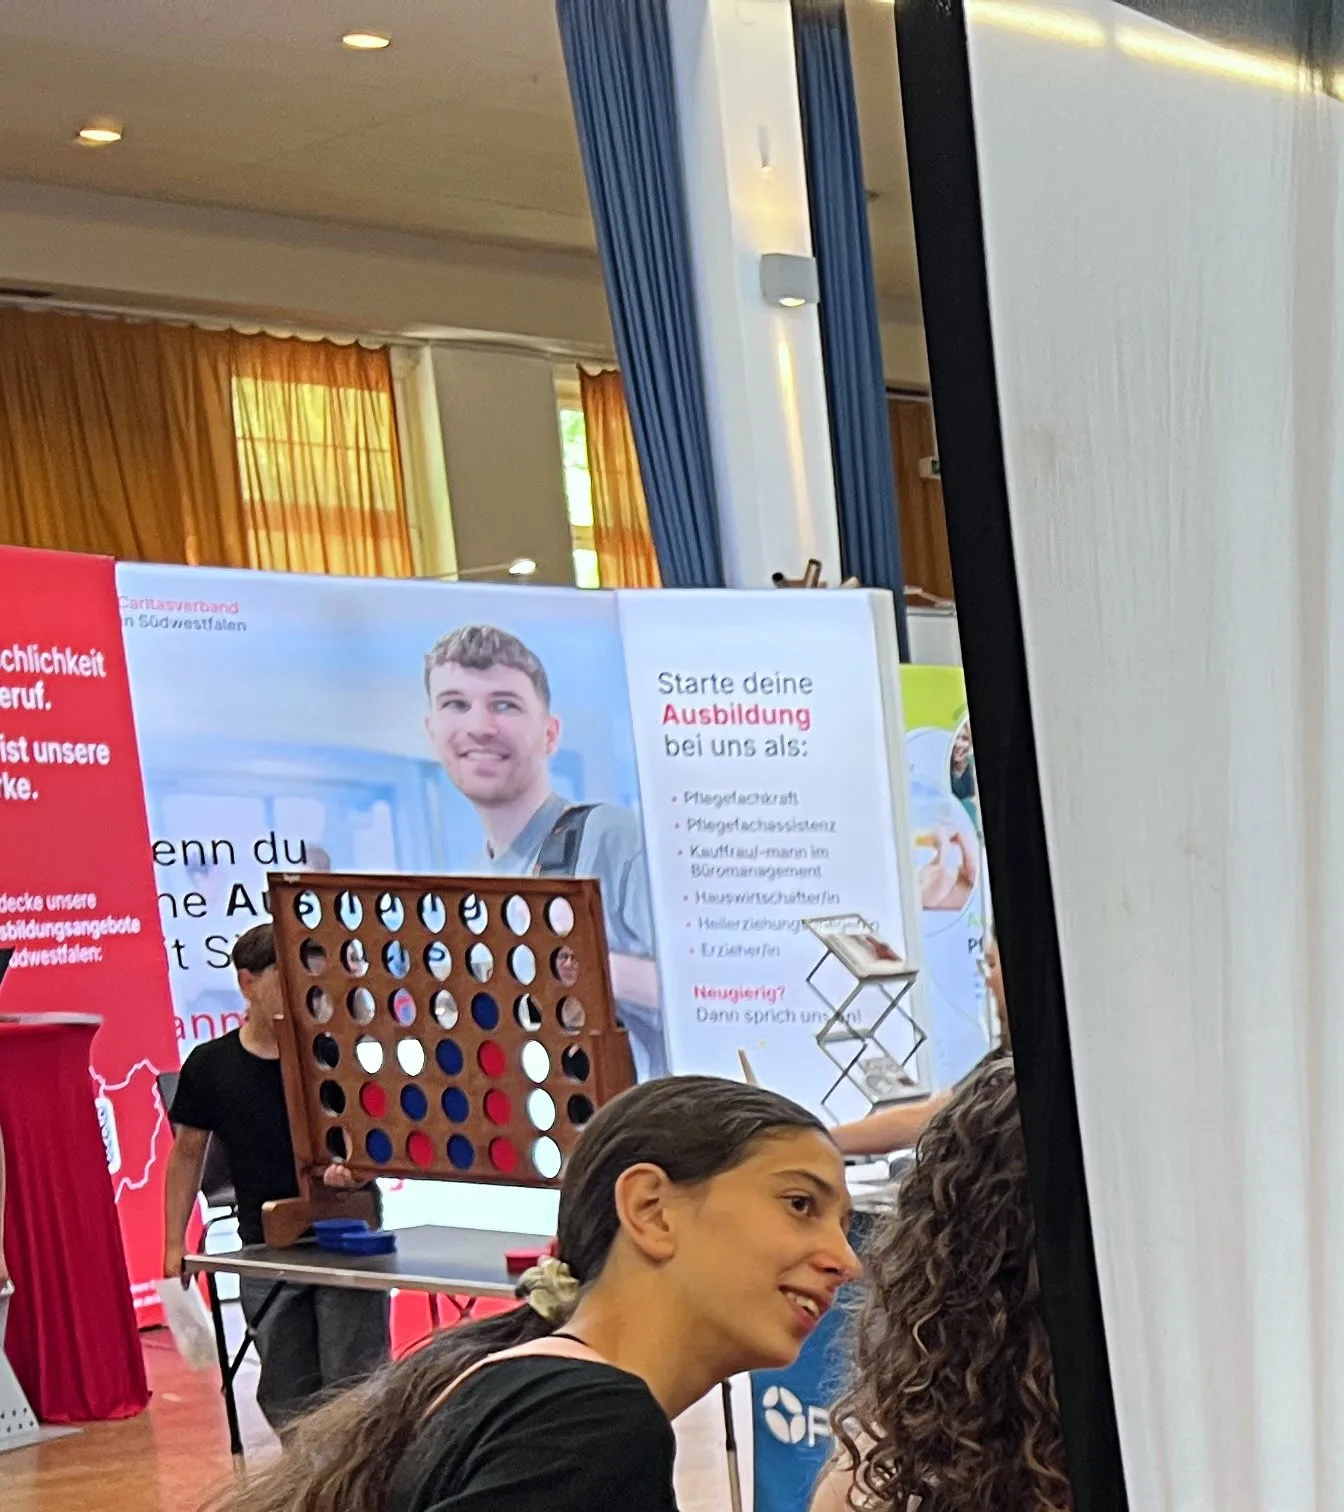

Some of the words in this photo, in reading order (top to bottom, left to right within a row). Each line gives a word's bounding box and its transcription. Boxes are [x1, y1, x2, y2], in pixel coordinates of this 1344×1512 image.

[119, 596, 239, 614] Caritasverband
[138, 614, 247, 632] Südwestfalen
[0, 642, 106, 678] chlichkeit
[657, 671, 735, 695] Starte
[743, 671, 814, 695] deine
[662, 703, 811, 731] Ausbildung
[33, 740, 111, 766] unsere
[664, 734, 703, 757] bei
[711, 738, 757, 757] uns
[764, 735, 809, 758] als:
[684, 790, 799, 808] Pflegefachkraft
[687, 817, 837, 836] Pflegefachassistenz
[253, 830, 308, 866] du
[690, 843, 808, 860] Kauffrau/-mann
[811, 844, 830, 859] im
[691, 863, 822, 881] Büromanagement
[46, 892, 97, 911] unsere
[695, 890, 841, 906] Hauswirtschafter/in
[701, 942, 780, 959] Erzieher/in
[694, 984, 786, 1005] Neugierig?
[696, 1007, 740, 1023] Dann
[744, 1006, 797, 1028] sprich
